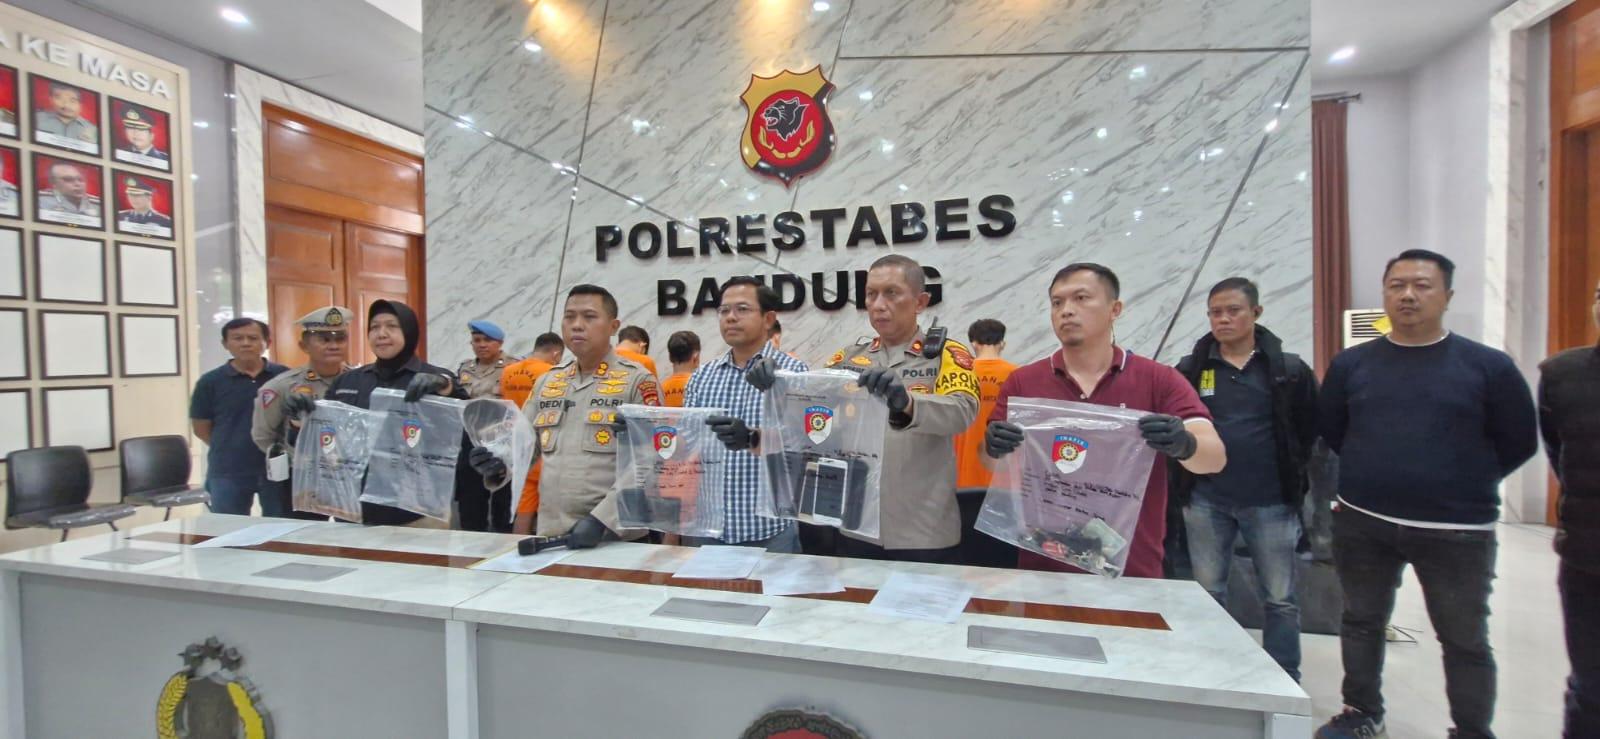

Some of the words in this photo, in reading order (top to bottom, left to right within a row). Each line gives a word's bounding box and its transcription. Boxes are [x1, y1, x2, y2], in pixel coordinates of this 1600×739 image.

[20, 32, 71, 68] KE
[80, 51, 171, 99] MASA
[595, 194, 1017, 263] POLRESTABES
[657, 265, 943, 316] BADUG
[902, 367, 938, 378] POLRI
[540, 400, 562, 409] DEDI
[590, 398, 624, 408] POLRI
